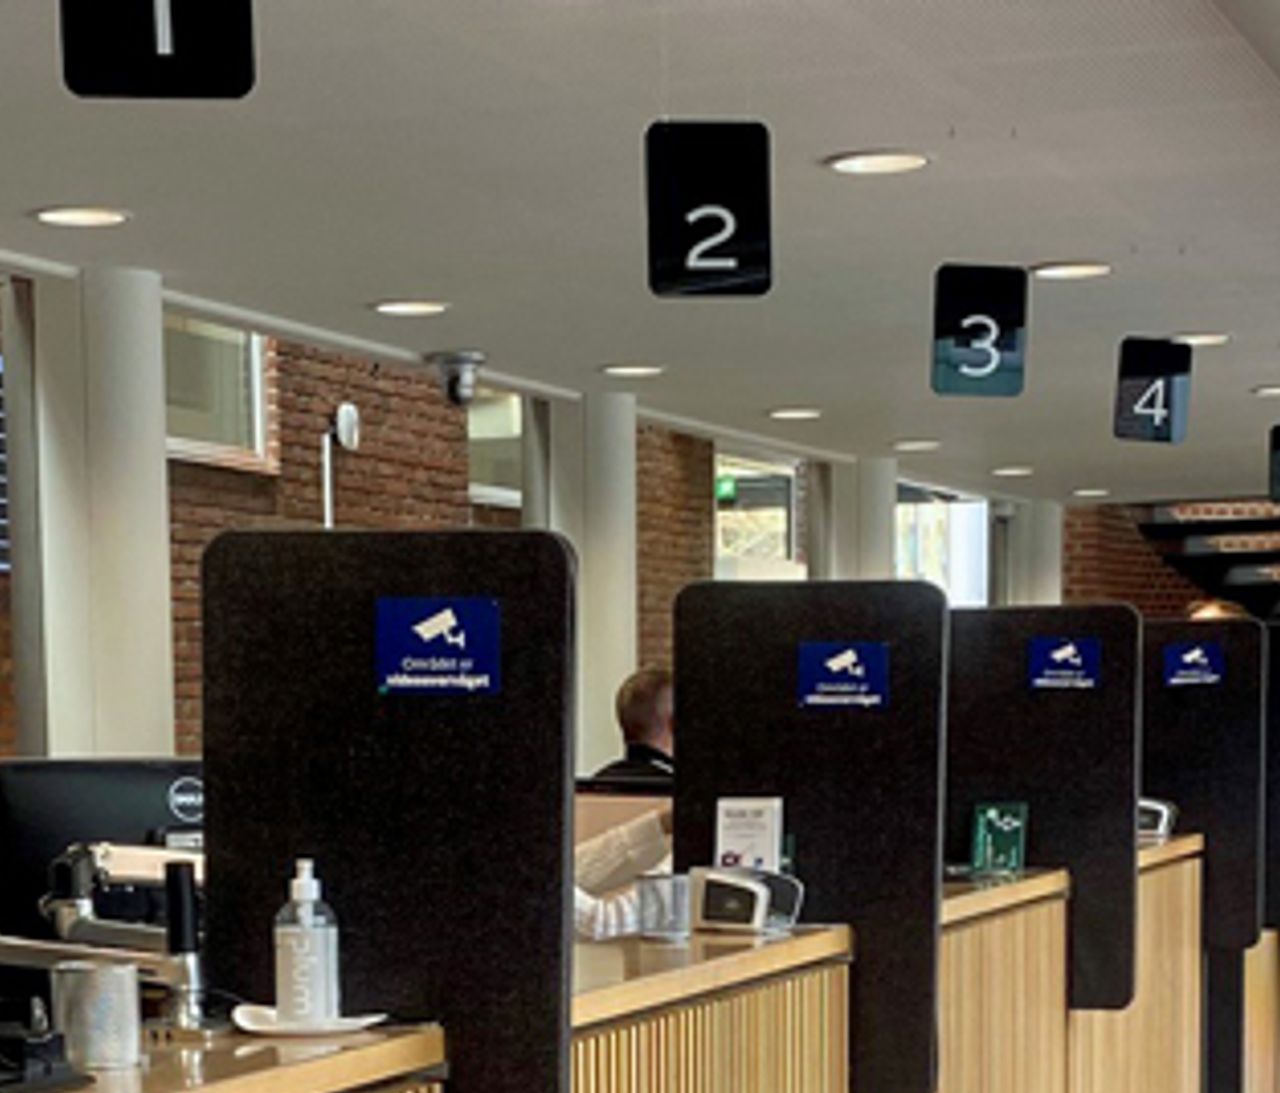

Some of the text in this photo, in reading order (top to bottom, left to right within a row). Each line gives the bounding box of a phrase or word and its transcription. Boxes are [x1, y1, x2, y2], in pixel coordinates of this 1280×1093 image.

[687, 206, 736, 268] 2
[961, 316, 999, 375] 3
[1135, 380, 1166, 424] 4
